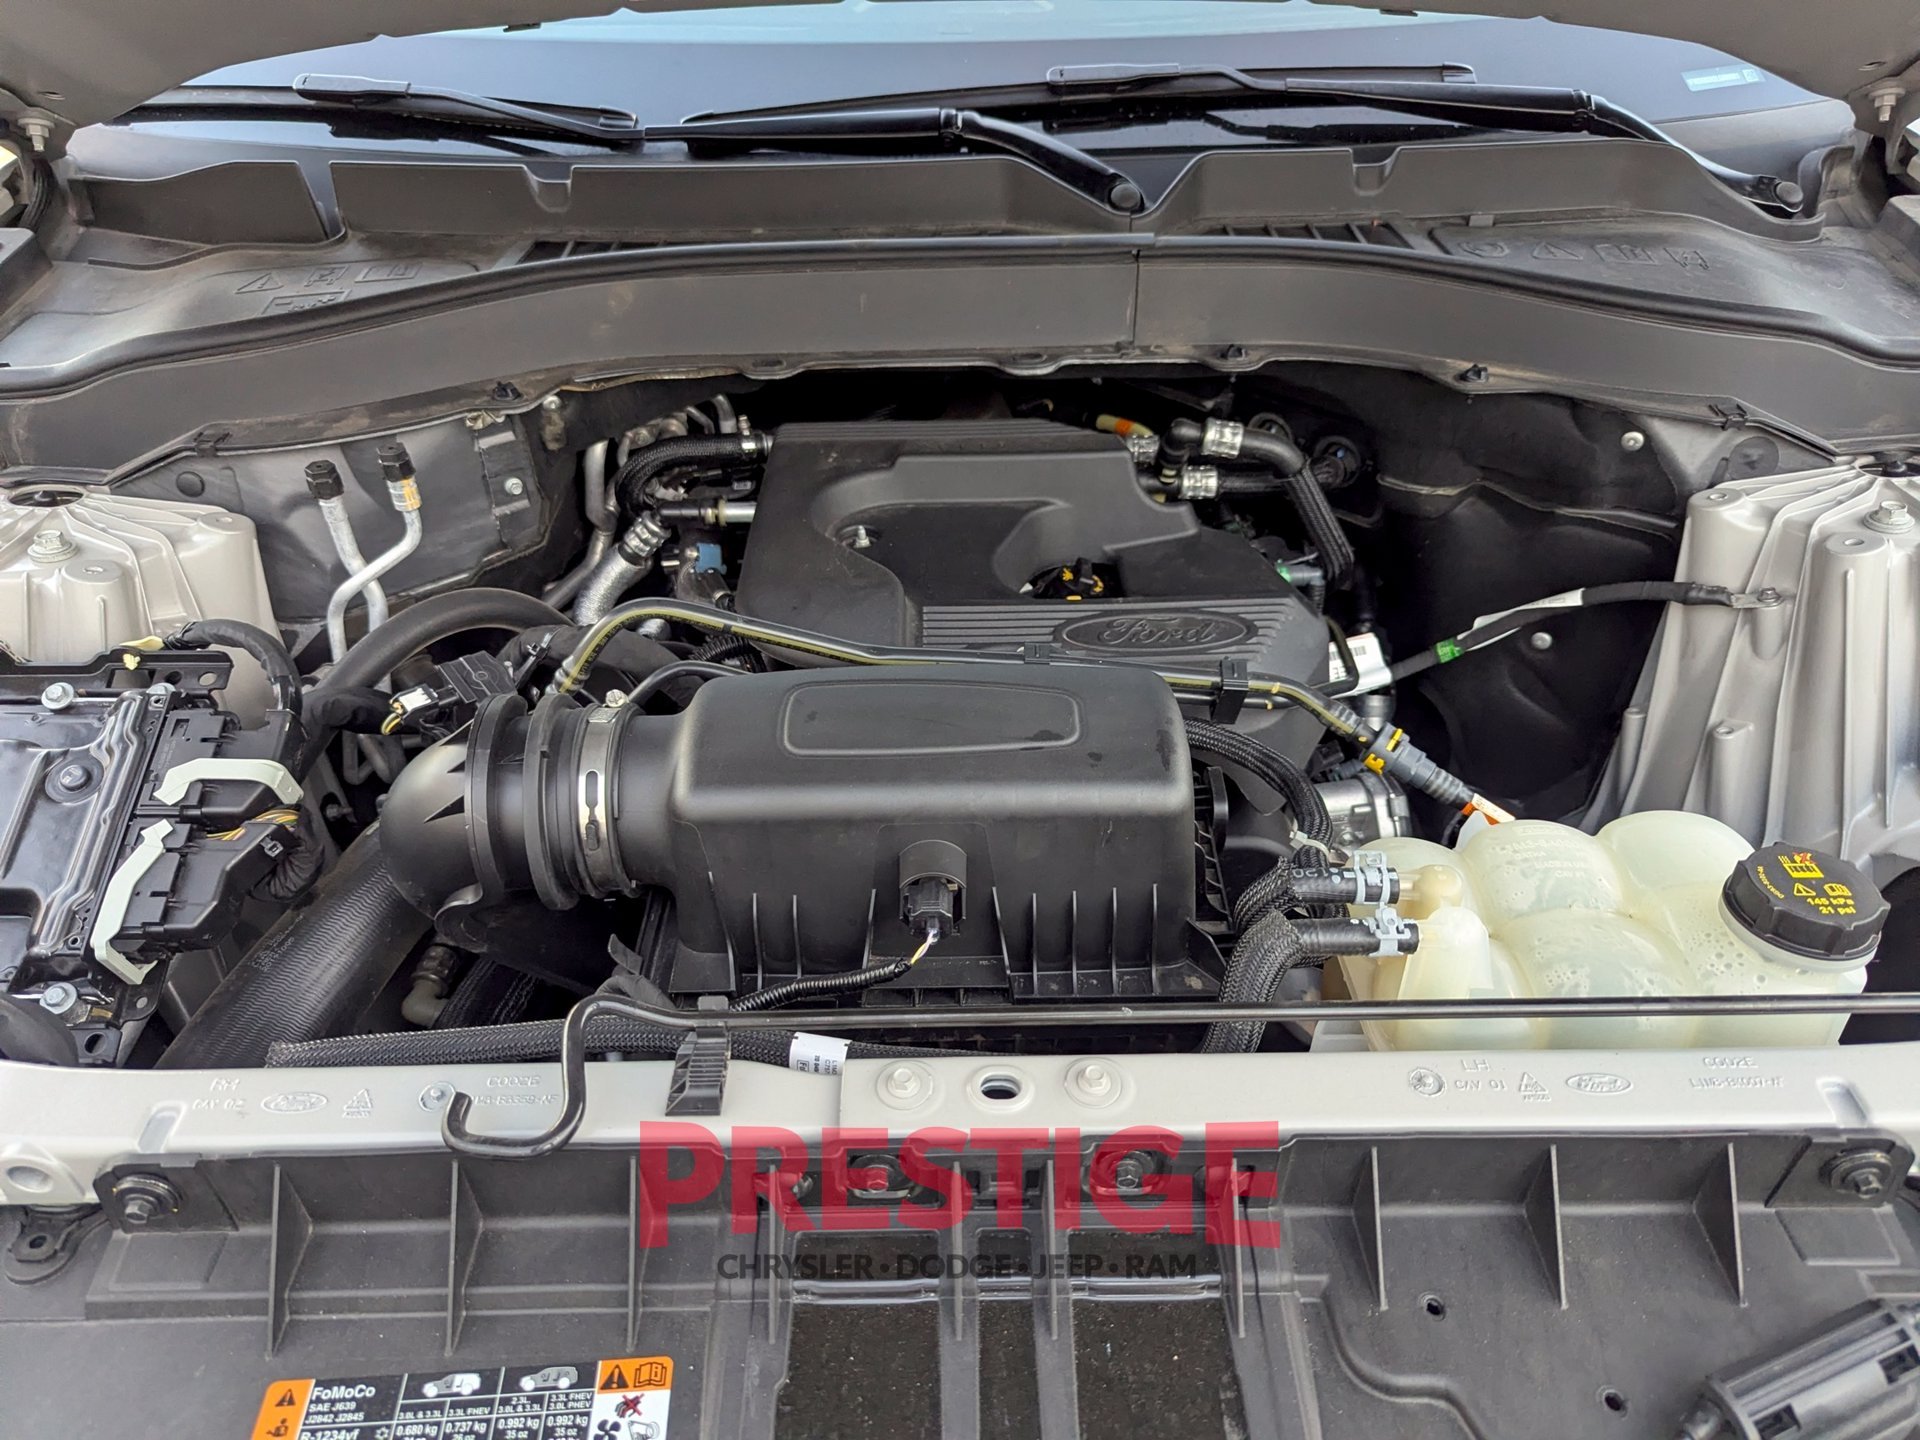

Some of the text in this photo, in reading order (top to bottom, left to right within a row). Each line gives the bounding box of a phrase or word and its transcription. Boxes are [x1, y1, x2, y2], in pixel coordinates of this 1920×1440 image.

[1819, 906, 1834, 914] 21
[312, 1384, 376, 1400] FoMoCo
[309, 1402, 331, 1412] SAE
[497, 1417, 540, 1429] 0.992 kg
[546, 1414, 588, 1427] 0.992 kg
[396, 1424, 438, 1436] 0.680 kg
[445, 1421, 487, 1434] 0.737 kg
[554, 1427, 578, 1436] 35 oz
[505, 1430, 529, 1439] 35 oz
